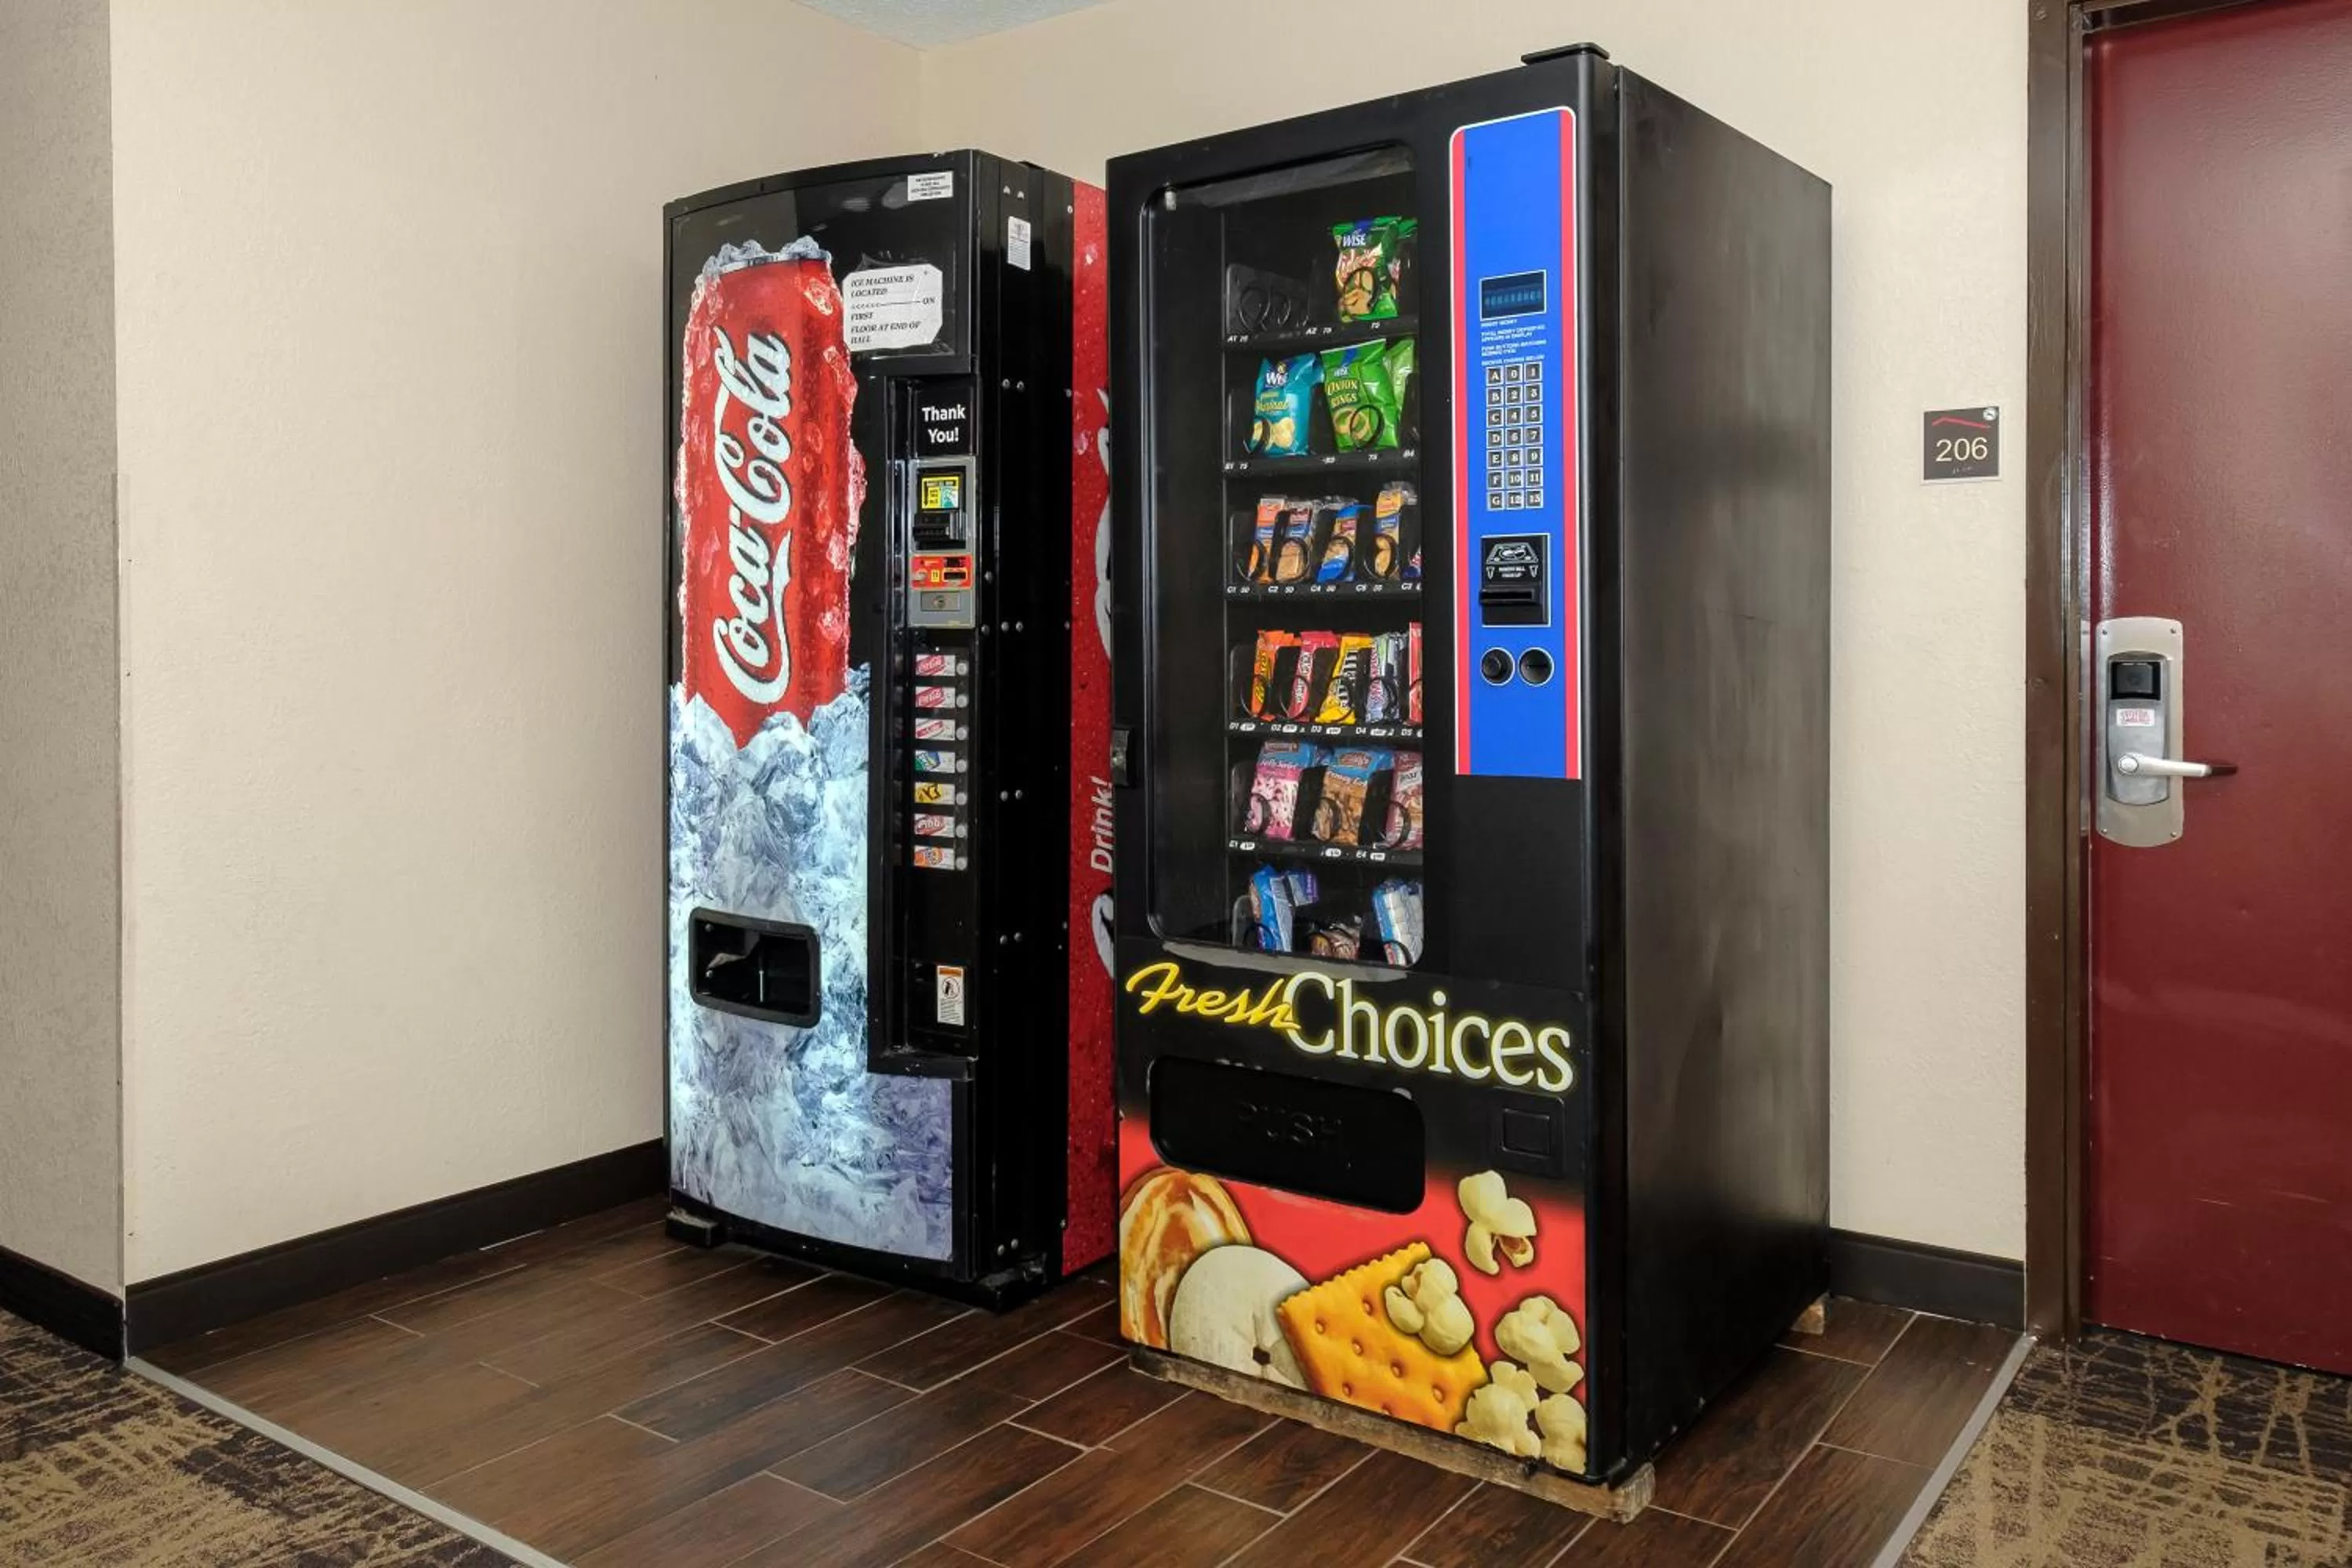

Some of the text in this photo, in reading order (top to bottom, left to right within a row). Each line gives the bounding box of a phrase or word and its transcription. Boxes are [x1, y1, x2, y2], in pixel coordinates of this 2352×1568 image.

[851, 278, 864, 287] ICE
[866, 275, 904, 285] MACHINE
[851, 288, 888, 297] LOCATED
[851, 311, 874, 321] FIRST
[851, 324, 877, 333] FLOOR
[909, 321, 922, 329] OF
[851, 335, 872, 344] HALL
[921, 404, 966, 422] Thank
[927, 426, 959, 444] You!
[1935, 437, 1988, 462] 206
[1091, 775, 1113, 874] Drink!
[1126, 961, 1575, 1093] Fresh Choices
